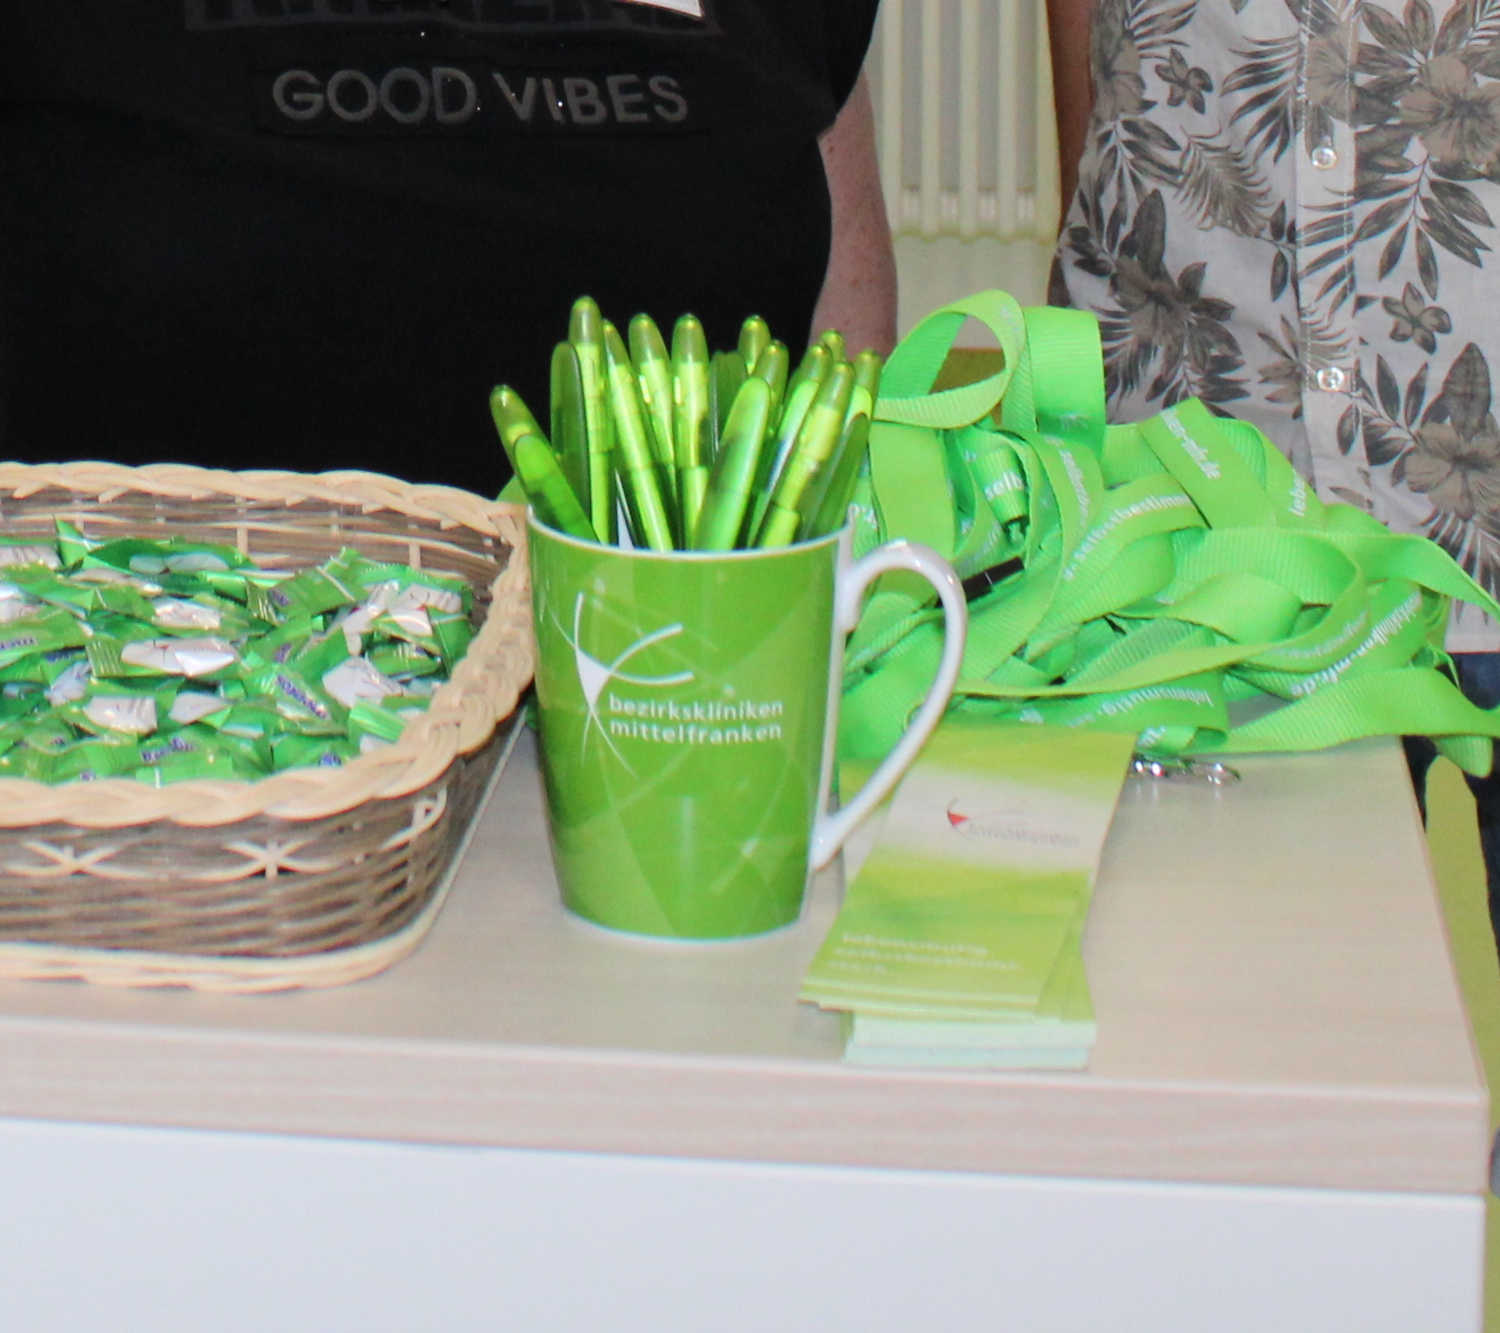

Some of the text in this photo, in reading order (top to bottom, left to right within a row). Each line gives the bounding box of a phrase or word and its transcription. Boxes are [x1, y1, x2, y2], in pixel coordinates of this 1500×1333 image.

[272, 66, 689, 125] GOOD VIBES
[609, 693, 783, 721] bezirkskliniken
[610, 719, 782, 744] mittelfranken
